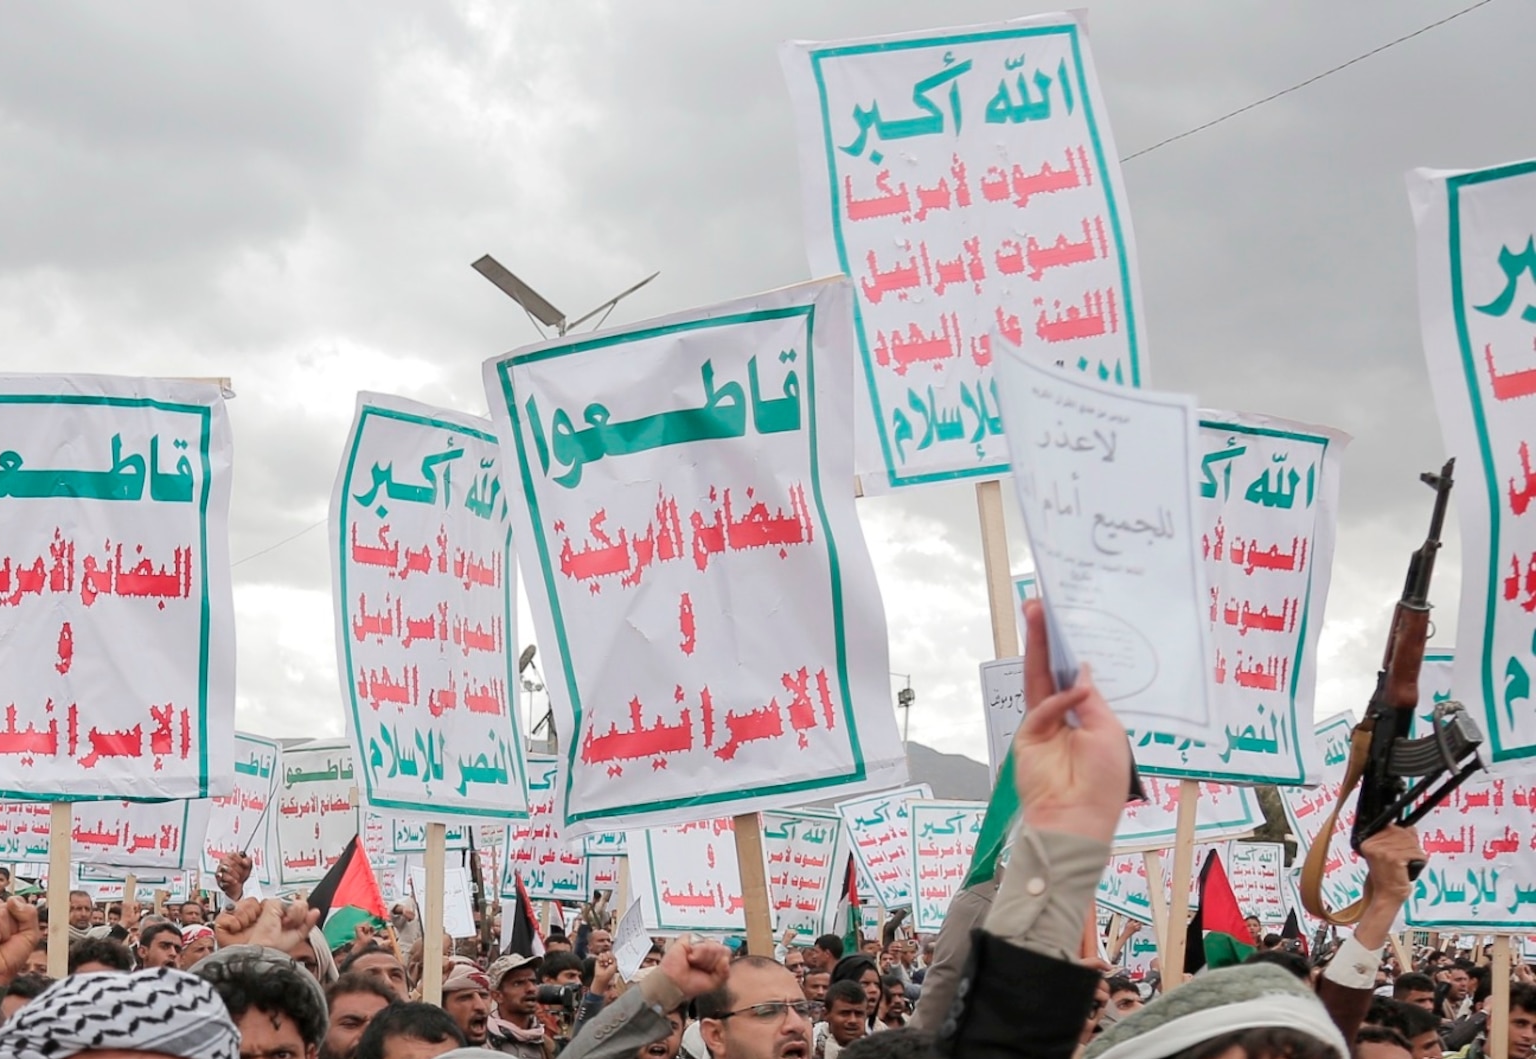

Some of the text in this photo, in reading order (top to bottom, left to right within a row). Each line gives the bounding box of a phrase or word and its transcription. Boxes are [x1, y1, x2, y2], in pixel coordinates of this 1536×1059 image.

[837, 49, 1075, 164] الله أكبر
[845, 145, 1092, 223] الموت لأمريكا
[861, 216, 1108, 304] الموت لإسرائيل
[1034, 288, 1118, 343] اللعنة
[874, 313, 962, 376] اليهود
[524, 347, 801, 490] قاطعوا
[352, 435, 509, 519] الله أكبر
[1200, 440, 1315, 510] الله أك
[554, 486, 814, 598] البضائع الأمريكية
[1092, 505, 1175, 556] للجميع
[1230, 536, 1308, 576] الموت
[81, 543, 192, 609] البضائع
[352, 525, 501, 591] الموت لأمريكا
[353, 595, 503, 657] الموت لإسرائيل
[677, 591, 697, 656] و
[1224, 599, 1298, 636] الموت
[53, 620, 75, 677] و
[1234, 655, 1289, 693] اللعنة
[358, 666, 507, 718] اللعنة على اليهود
[581, 667, 835, 777] الإسرائيلية
[1217, 703, 1287, 763] النصر
[234, 752, 270, 778] قاط
[282, 757, 353, 790] قاطعوا
[366, 724, 519, 801] النصر للإسلام
[529, 765, 557, 790] أك
[71, 819, 179, 856] الإسرائيلية
[445, 823, 466, 840] النص
[764, 819, 834, 844] الله أك
[852, 801, 891, 832] أكبر
[918, 811, 967, 840] أكبر
[794, 852, 830, 867] الموت
[1422, 825, 1518, 861] على اليهو
[549, 870, 583, 894] النصر
[791, 874, 825, 890] الموت
[1413, 867, 1499, 917] للإسلام
